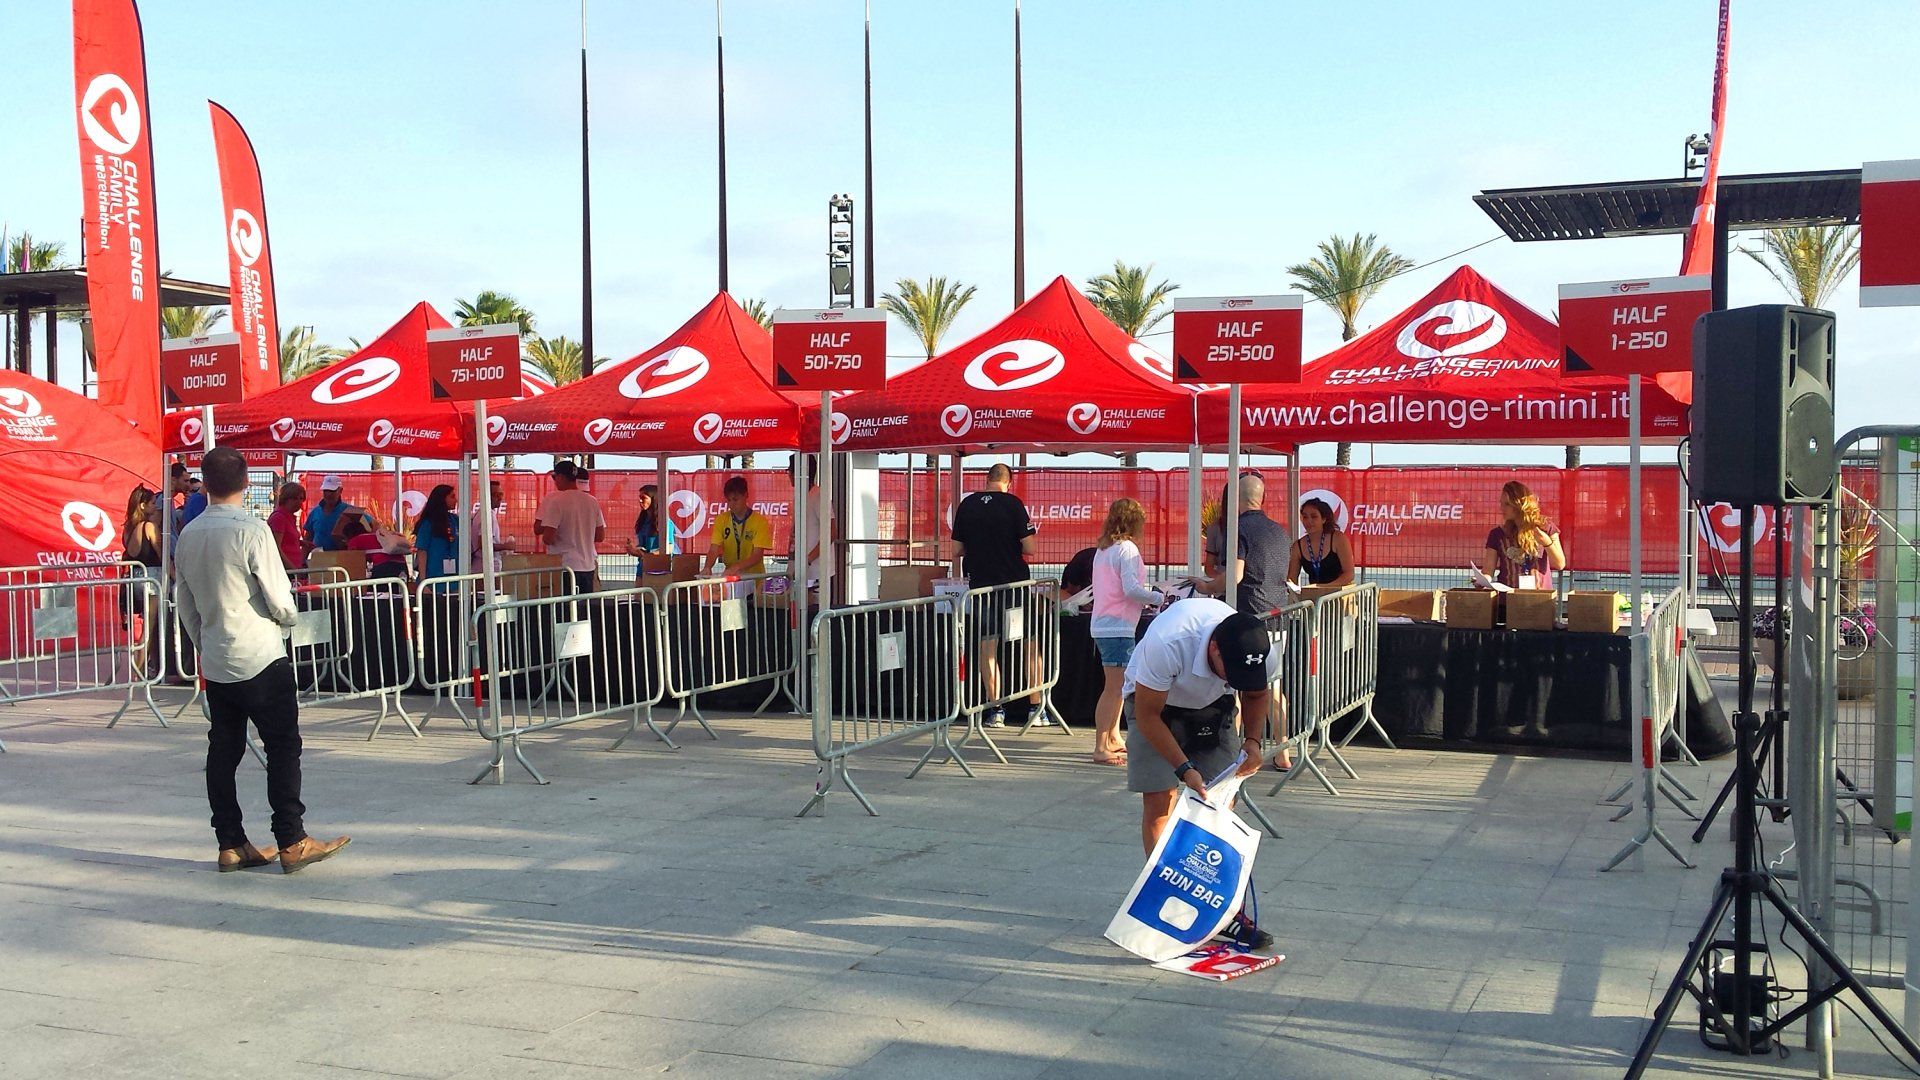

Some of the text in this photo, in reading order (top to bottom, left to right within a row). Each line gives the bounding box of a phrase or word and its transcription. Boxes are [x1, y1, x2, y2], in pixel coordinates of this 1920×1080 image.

[108, 155, 125, 225] FAMILY
[123, 160, 143, 302] CHALLENGE
[250, 269, 268, 371] CHALLENGE
[1613, 305, 1667, 325] HALF
[1217, 321, 1263, 338] HALF
[810, 332, 851, 348] HALF
[190, 352, 218, 368] HALF
[460, 346, 493, 362] HALF
[1207, 344, 1275, 362] 251-500
[804, 354, 862, 370] 501-750
[451, 365, 504, 383] 751-1000
[182, 373, 227, 390] 1001-1100
[974, 409, 1034, 419] CHALLENGE
[1103, 408, 1166, 419] CHALLENGE
[1245, 390, 1630, 429] www.challenge-rimini.it
[296, 421, 344, 433] CHALLENGE
[508, 422, 558, 431] CHALLENGE
[613, 421, 666, 430] CHALLENGE
[724, 418, 779, 428] CHALLENGE
[852, 414, 909, 428] CHALLENGE
[973, 419, 1002, 429] FAMILY
[1101, 419, 1132, 430] FAMILY
[214, 424, 250, 434] ALLENGE
[294, 430, 318, 439] FAMILY
[393, 427, 443, 440] CHALLENGE
[505, 431, 530, 440] FAMILY
[610, 430, 637, 440] FAMILY
[721, 428, 750, 438] FAMILY
[851, 427, 879, 438] FAMILY
[391, 436, 416, 446] FAMILY
[1353, 504, 1464, 520] CHALLENGE
[725, 527, 731, 540] 9
[1350, 521, 1403, 536] FAMILY
[37, 551, 122, 567] CHALLENGE
[1159, 866, 1194, 892] RUN
[1190, 883, 1225, 909] BAG
